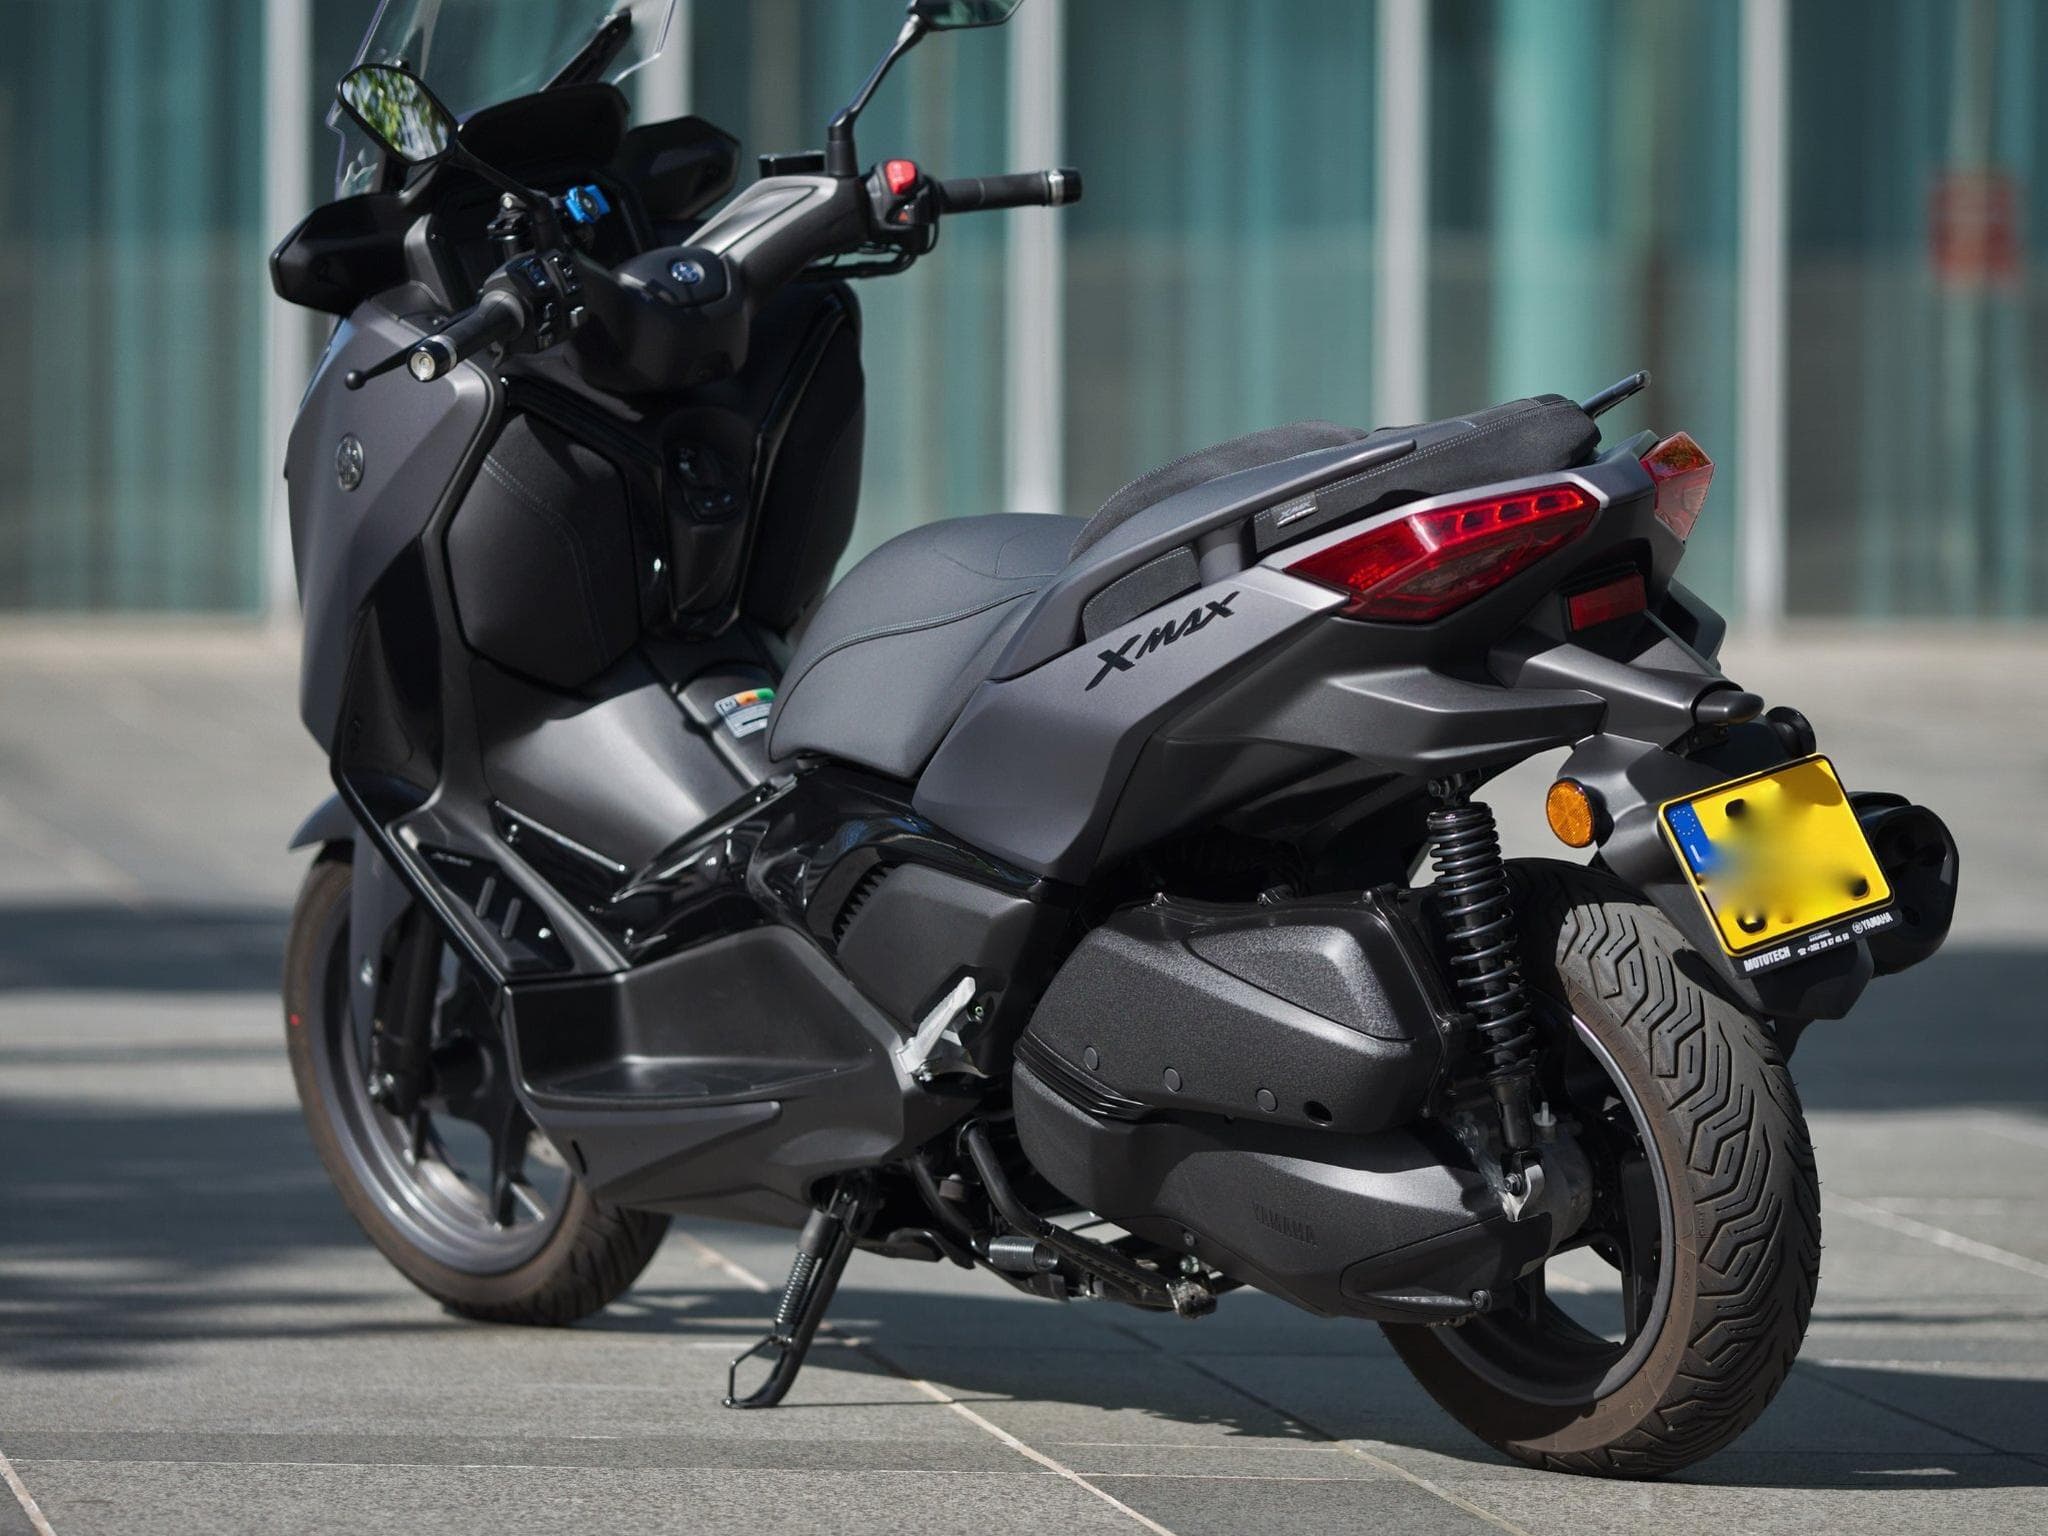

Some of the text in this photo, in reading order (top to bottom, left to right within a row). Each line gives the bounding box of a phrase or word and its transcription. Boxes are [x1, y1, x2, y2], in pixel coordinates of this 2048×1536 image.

[1085, 591, 1240, 691] XMAX
[1861, 911, 1894, 930] YAMAHA
[1253, 1202, 1319, 1247] YAMAHA
